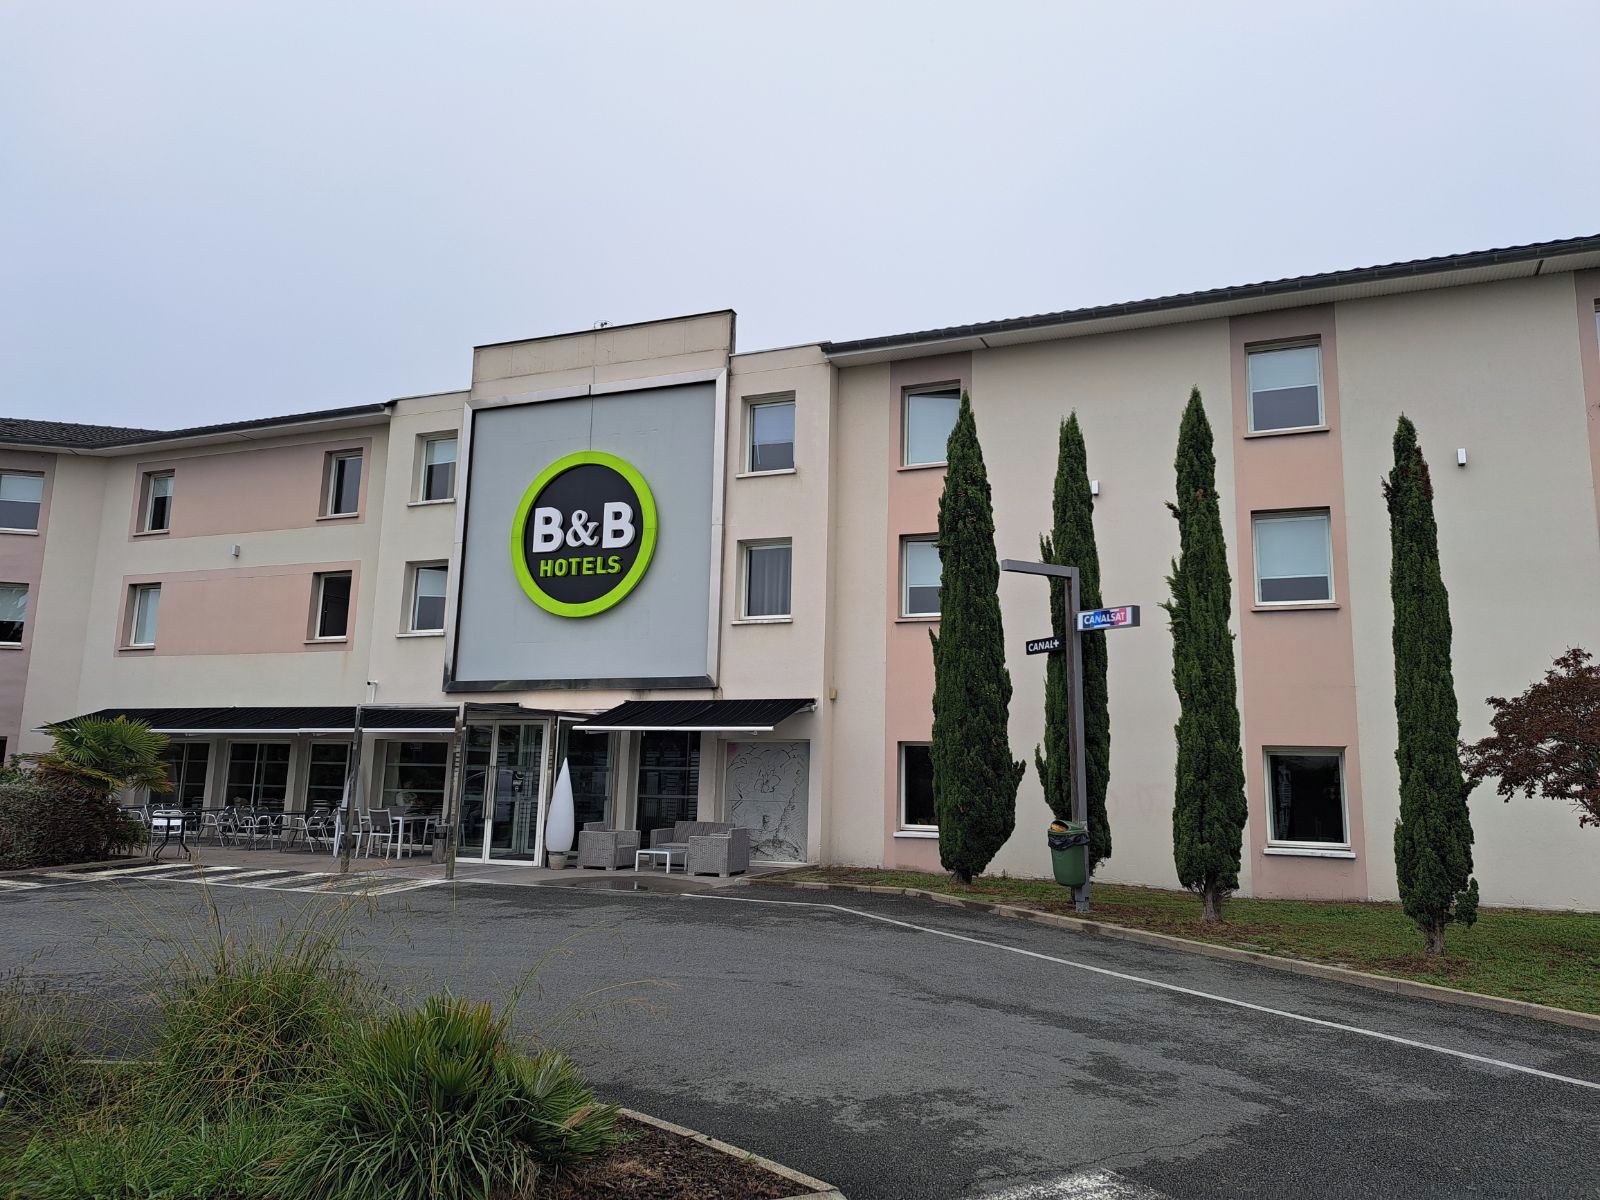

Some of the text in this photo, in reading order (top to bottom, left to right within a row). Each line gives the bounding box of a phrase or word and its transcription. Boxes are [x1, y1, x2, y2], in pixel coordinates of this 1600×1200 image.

[532, 501, 636, 553] B&B
[539, 555, 622, 577] HOTELS
[1083, 611, 1126, 625] CANALSAT
[1028, 639, 1060, 652] CANAL+
